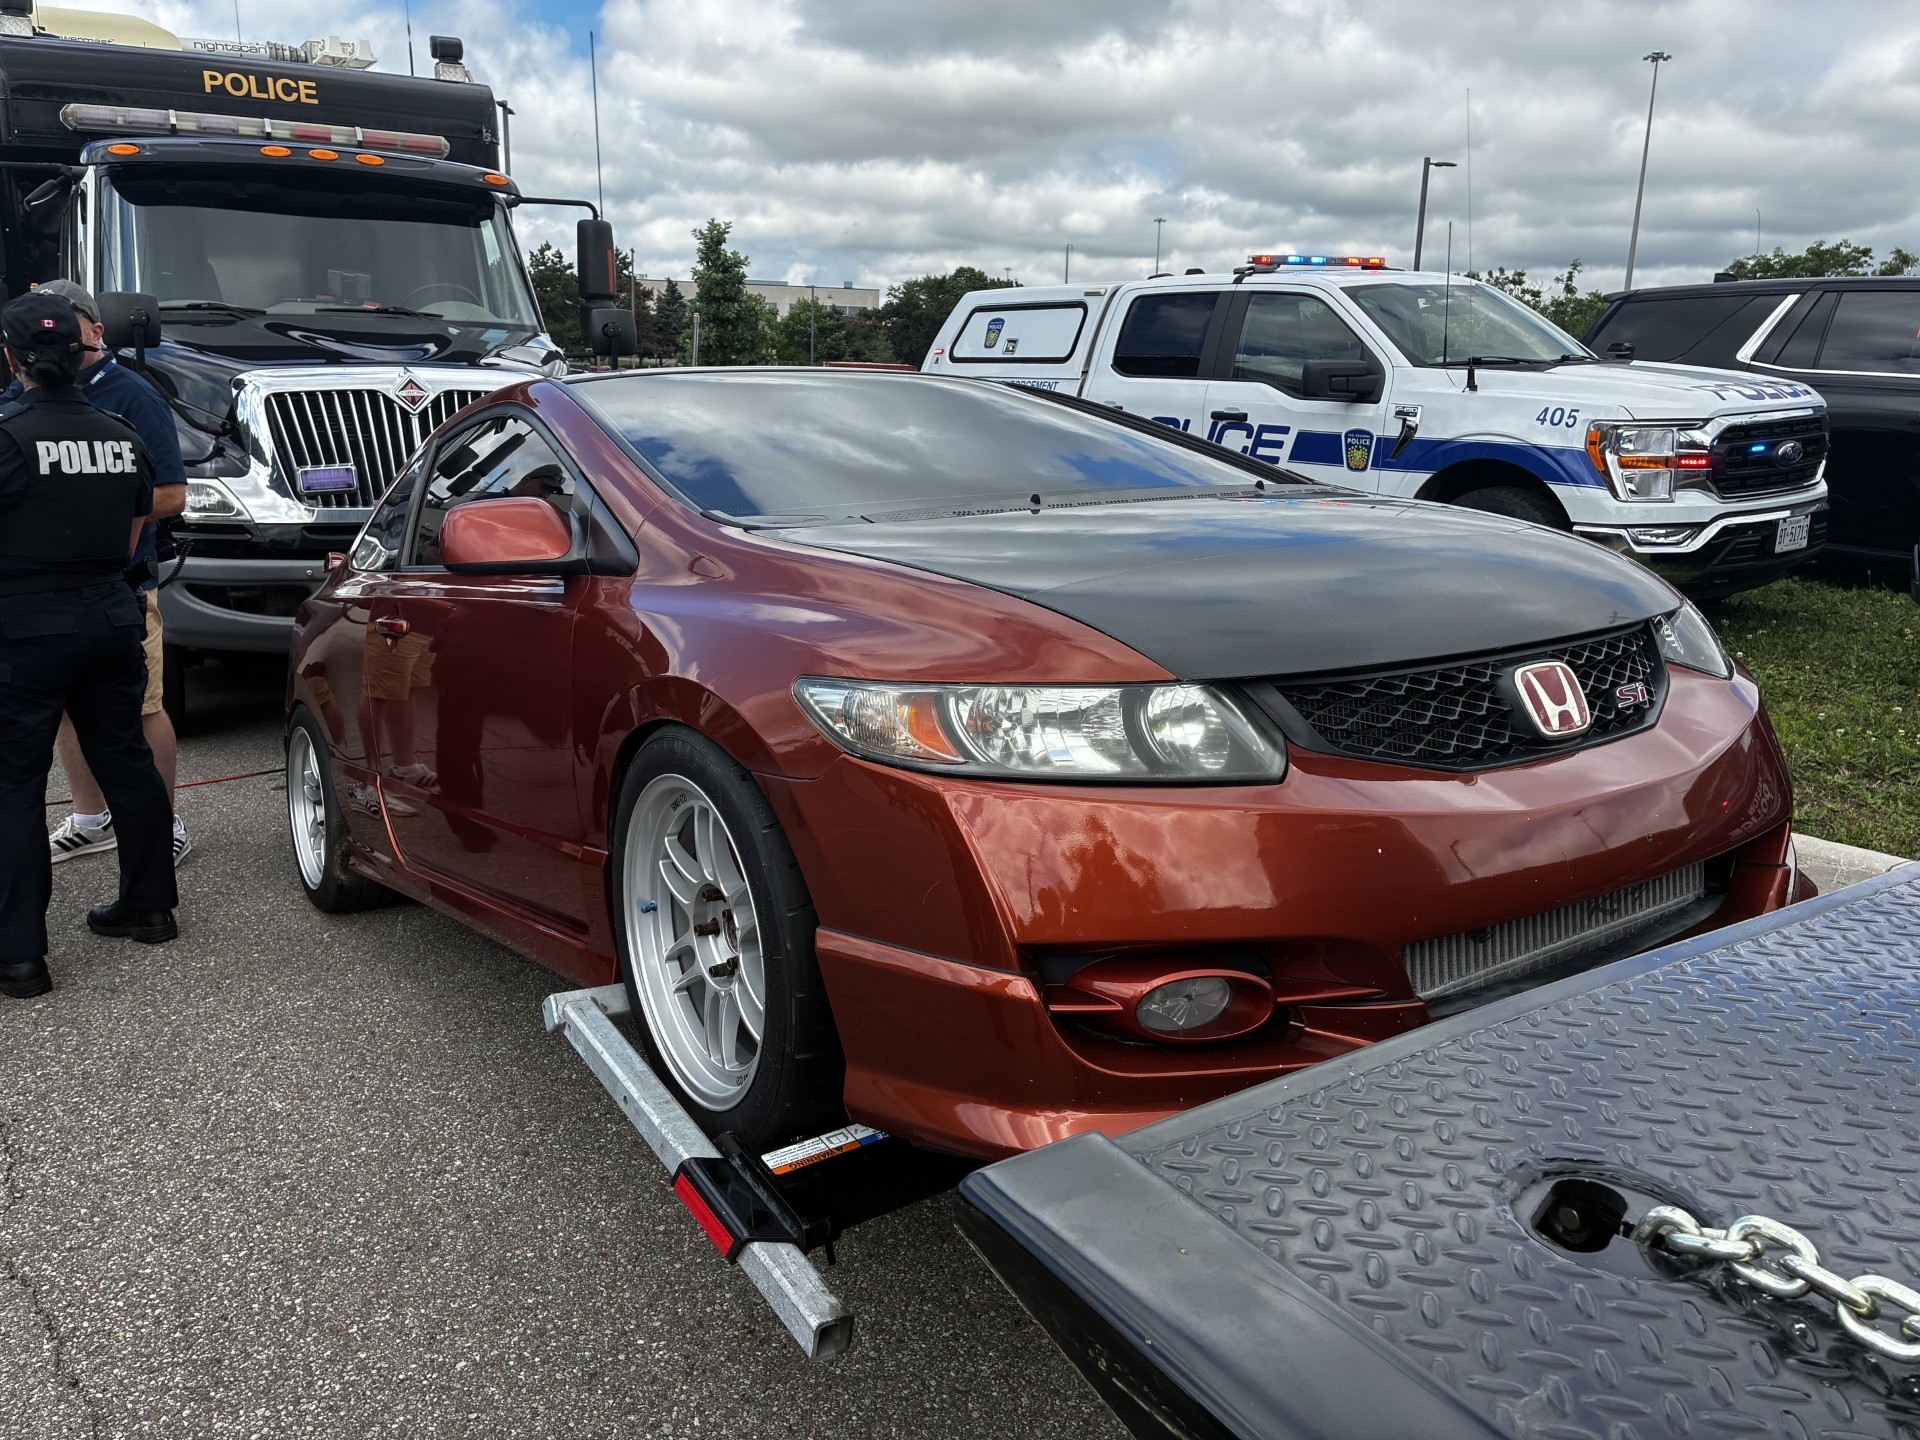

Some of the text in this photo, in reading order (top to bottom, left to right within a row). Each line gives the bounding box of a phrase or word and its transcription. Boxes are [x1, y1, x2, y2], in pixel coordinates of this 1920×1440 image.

[193, 40, 267, 55] nightscan
[202, 70, 319, 105] POLICE
[1535, 406, 1580, 429] 405
[1347, 438, 1371, 446] POLICE
[35, 440, 138, 475] POLICE
[1616, 681, 1648, 709] Si
[789, 1150, 836, 1170] WARNING
